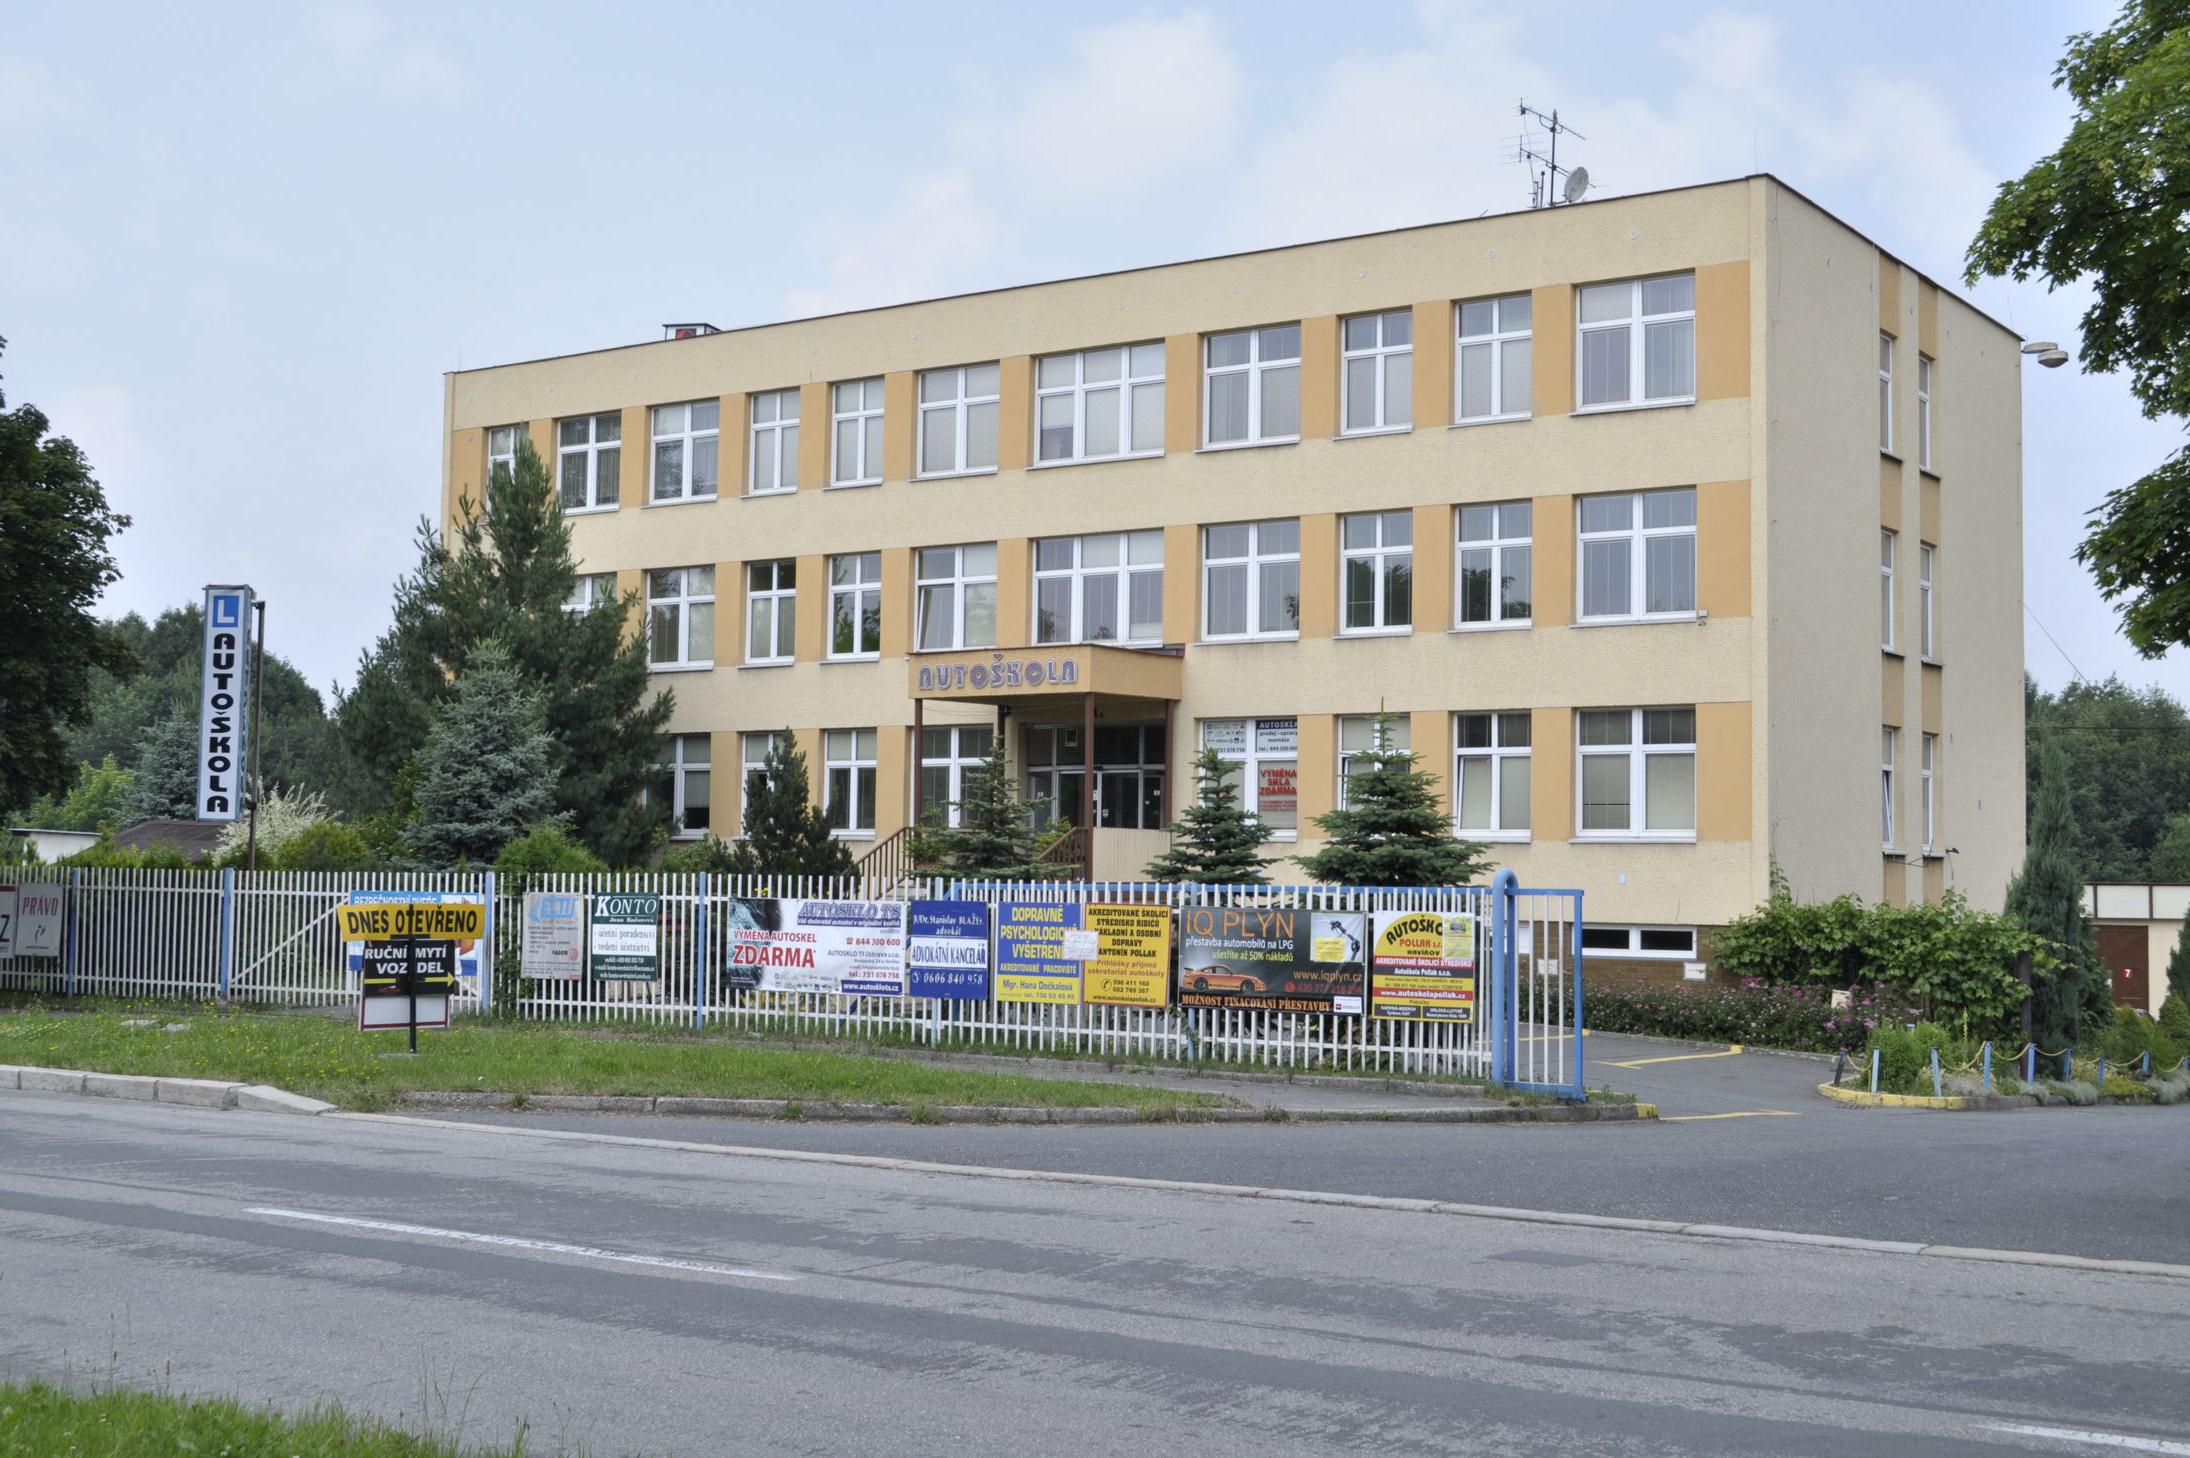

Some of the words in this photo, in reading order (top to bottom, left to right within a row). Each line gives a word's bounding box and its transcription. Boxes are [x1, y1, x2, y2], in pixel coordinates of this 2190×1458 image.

[217, 599, 235, 623] L
[918, 653, 1079, 690] AUTOŠKOLA
[206, 632, 236, 813] AUTOŠKOLA
[22, 895, 59, 916] PRÁVO
[595, 895, 657, 917] KONTO
[1088, 908, 1140, 917] AKREDITOVANÉ
[347, 909, 389, 934] DNES
[929, 914, 957, 924] Stanislav
[1186, 910, 1214, 936] IQ
[1223, 911, 1295, 938] PLYN
[733, 929, 772, 942] VÝMĚNA
[771, 930, 817, 943] AUTOSKEL
[1000, 923, 1077, 941] PSYCHOLOGIC
[1129, 929, 1134, 937] A
[855, 937, 870, 945] 844
[886, 938, 900, 946] 600
[1112, 939, 1143, 947] DOPRAVY
[1185, 936, 1222, 948] přestavba
[1223, 937, 1266, 949] automobilů
[1267, 941, 1277, 949] na
[1278, 939, 1293, 949] LPG
[1400, 939, 1430, 947] POLLAK
[364, 944, 408, 959] RUČNÍ
[415, 943, 447, 958] MYTÍ
[912, 941, 950, 963] ADVOKÁTNÍ
[950, 943, 986, 964] KANCELÁŘ
[1130, 949, 1157, 957] POLLAK
[1240, 950, 1249, 960] až
[1249, 951, 1265, 961] 50%
[1265, 950, 1294, 962] nákladů
[376, 961, 445, 974] VOZDEL
[1376, 957, 1417, 966] AKREDITOVANÉ
[923, 972, 946, 983] 0606
[947, 973, 965, 984] 840
[1293, 970, 1362, 982] www.iqplyn.cz
[1394, 968, 1420, 976] Autoškola
[1421, 968, 1438, 976] Pollak
[843, 982, 899, 992] www.autosklots.cz
[1002, 980, 1018, 990] Mgr.
[1020, 980, 1037, 989] Hana
[1380, 990, 1466, 999] www.autoskolapollak.cz
[1182, 993, 1222, 1005] MOŽNOST
[1278, 997, 1331, 1011] PŘESTAVBY
